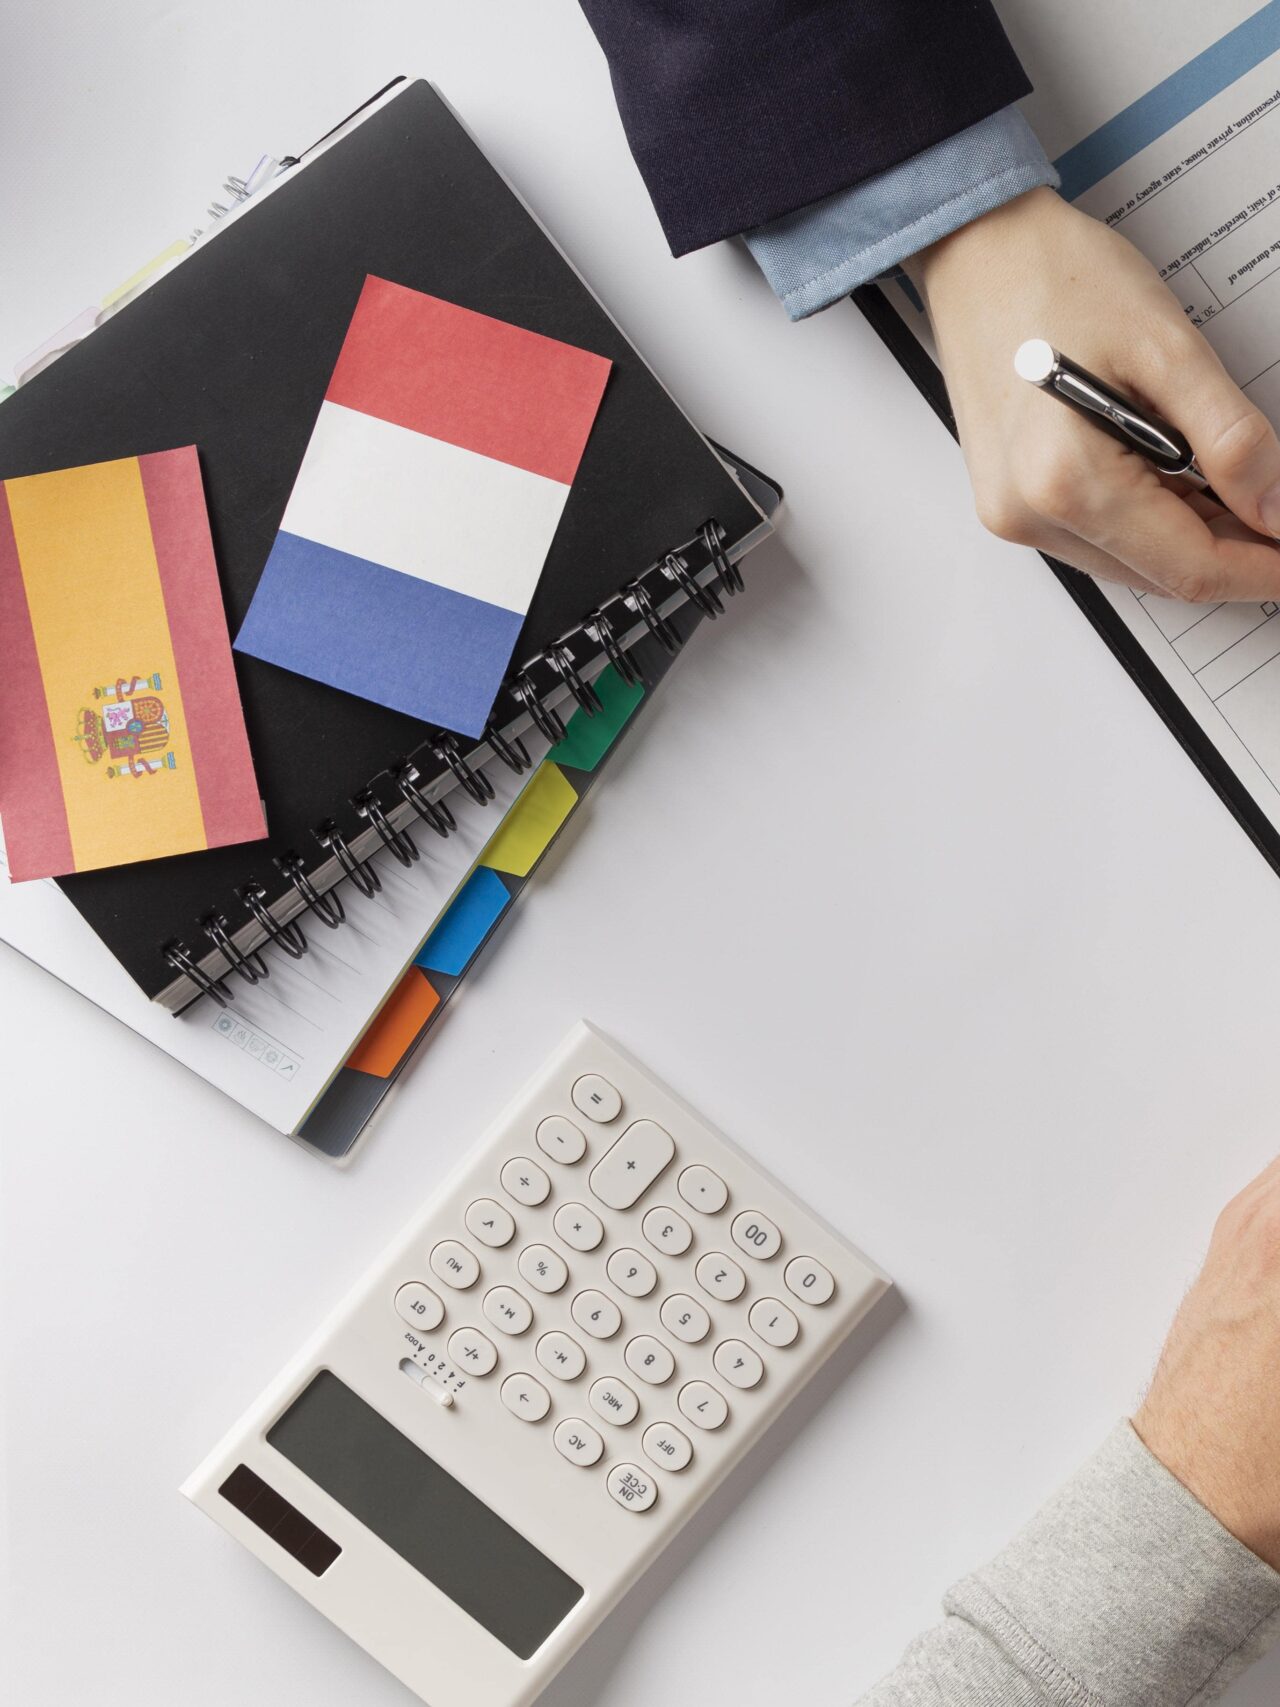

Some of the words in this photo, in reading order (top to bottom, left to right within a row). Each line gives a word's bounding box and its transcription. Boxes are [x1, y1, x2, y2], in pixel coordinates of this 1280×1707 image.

[1205, 124, 1234, 150] private
[1179, 145, 1209, 166] house,
[1161, 164, 1183, 182] state
[1134, 178, 1163, 202] agency
[1265, 188, 1277, 201] of
[1125, 198, 1136, 209] or
[1245, 195, 1268, 213] visit;
[1104, 206, 1125, 225] other
[1208, 209, 1249, 238] therefore,
[1179, 235, 1213, 262] indicate
[1166, 258, 1181, 271] the
[1235, 248, 1270, 276] duration
[1226, 272, 1238, 286] of
[660, 1224, 674, 1238] 3
[743, 1223, 768, 1247] 00
[445, 1256, 463, 1273] MU
[625, 1266, 638, 1279] 6
[713, 1268, 728, 1283] 2
[801, 1272, 817, 1288] 0
[409, 1299, 427, 1315] GT
[589, 1309, 602, 1321] 9
[677, 1311, 692, 1326] 5
[767, 1315, 779, 1328] 1
[642, 1352, 656, 1366] 8
[732, 1356, 745, 1369] 4
[601, 1390, 623, 1412] MRC
[695, 1400, 709, 1413] 7
[567, 1434, 587, 1451] AC
[655, 1438, 676, 1456] OFF
[617, 1485, 635, 1502] ON
